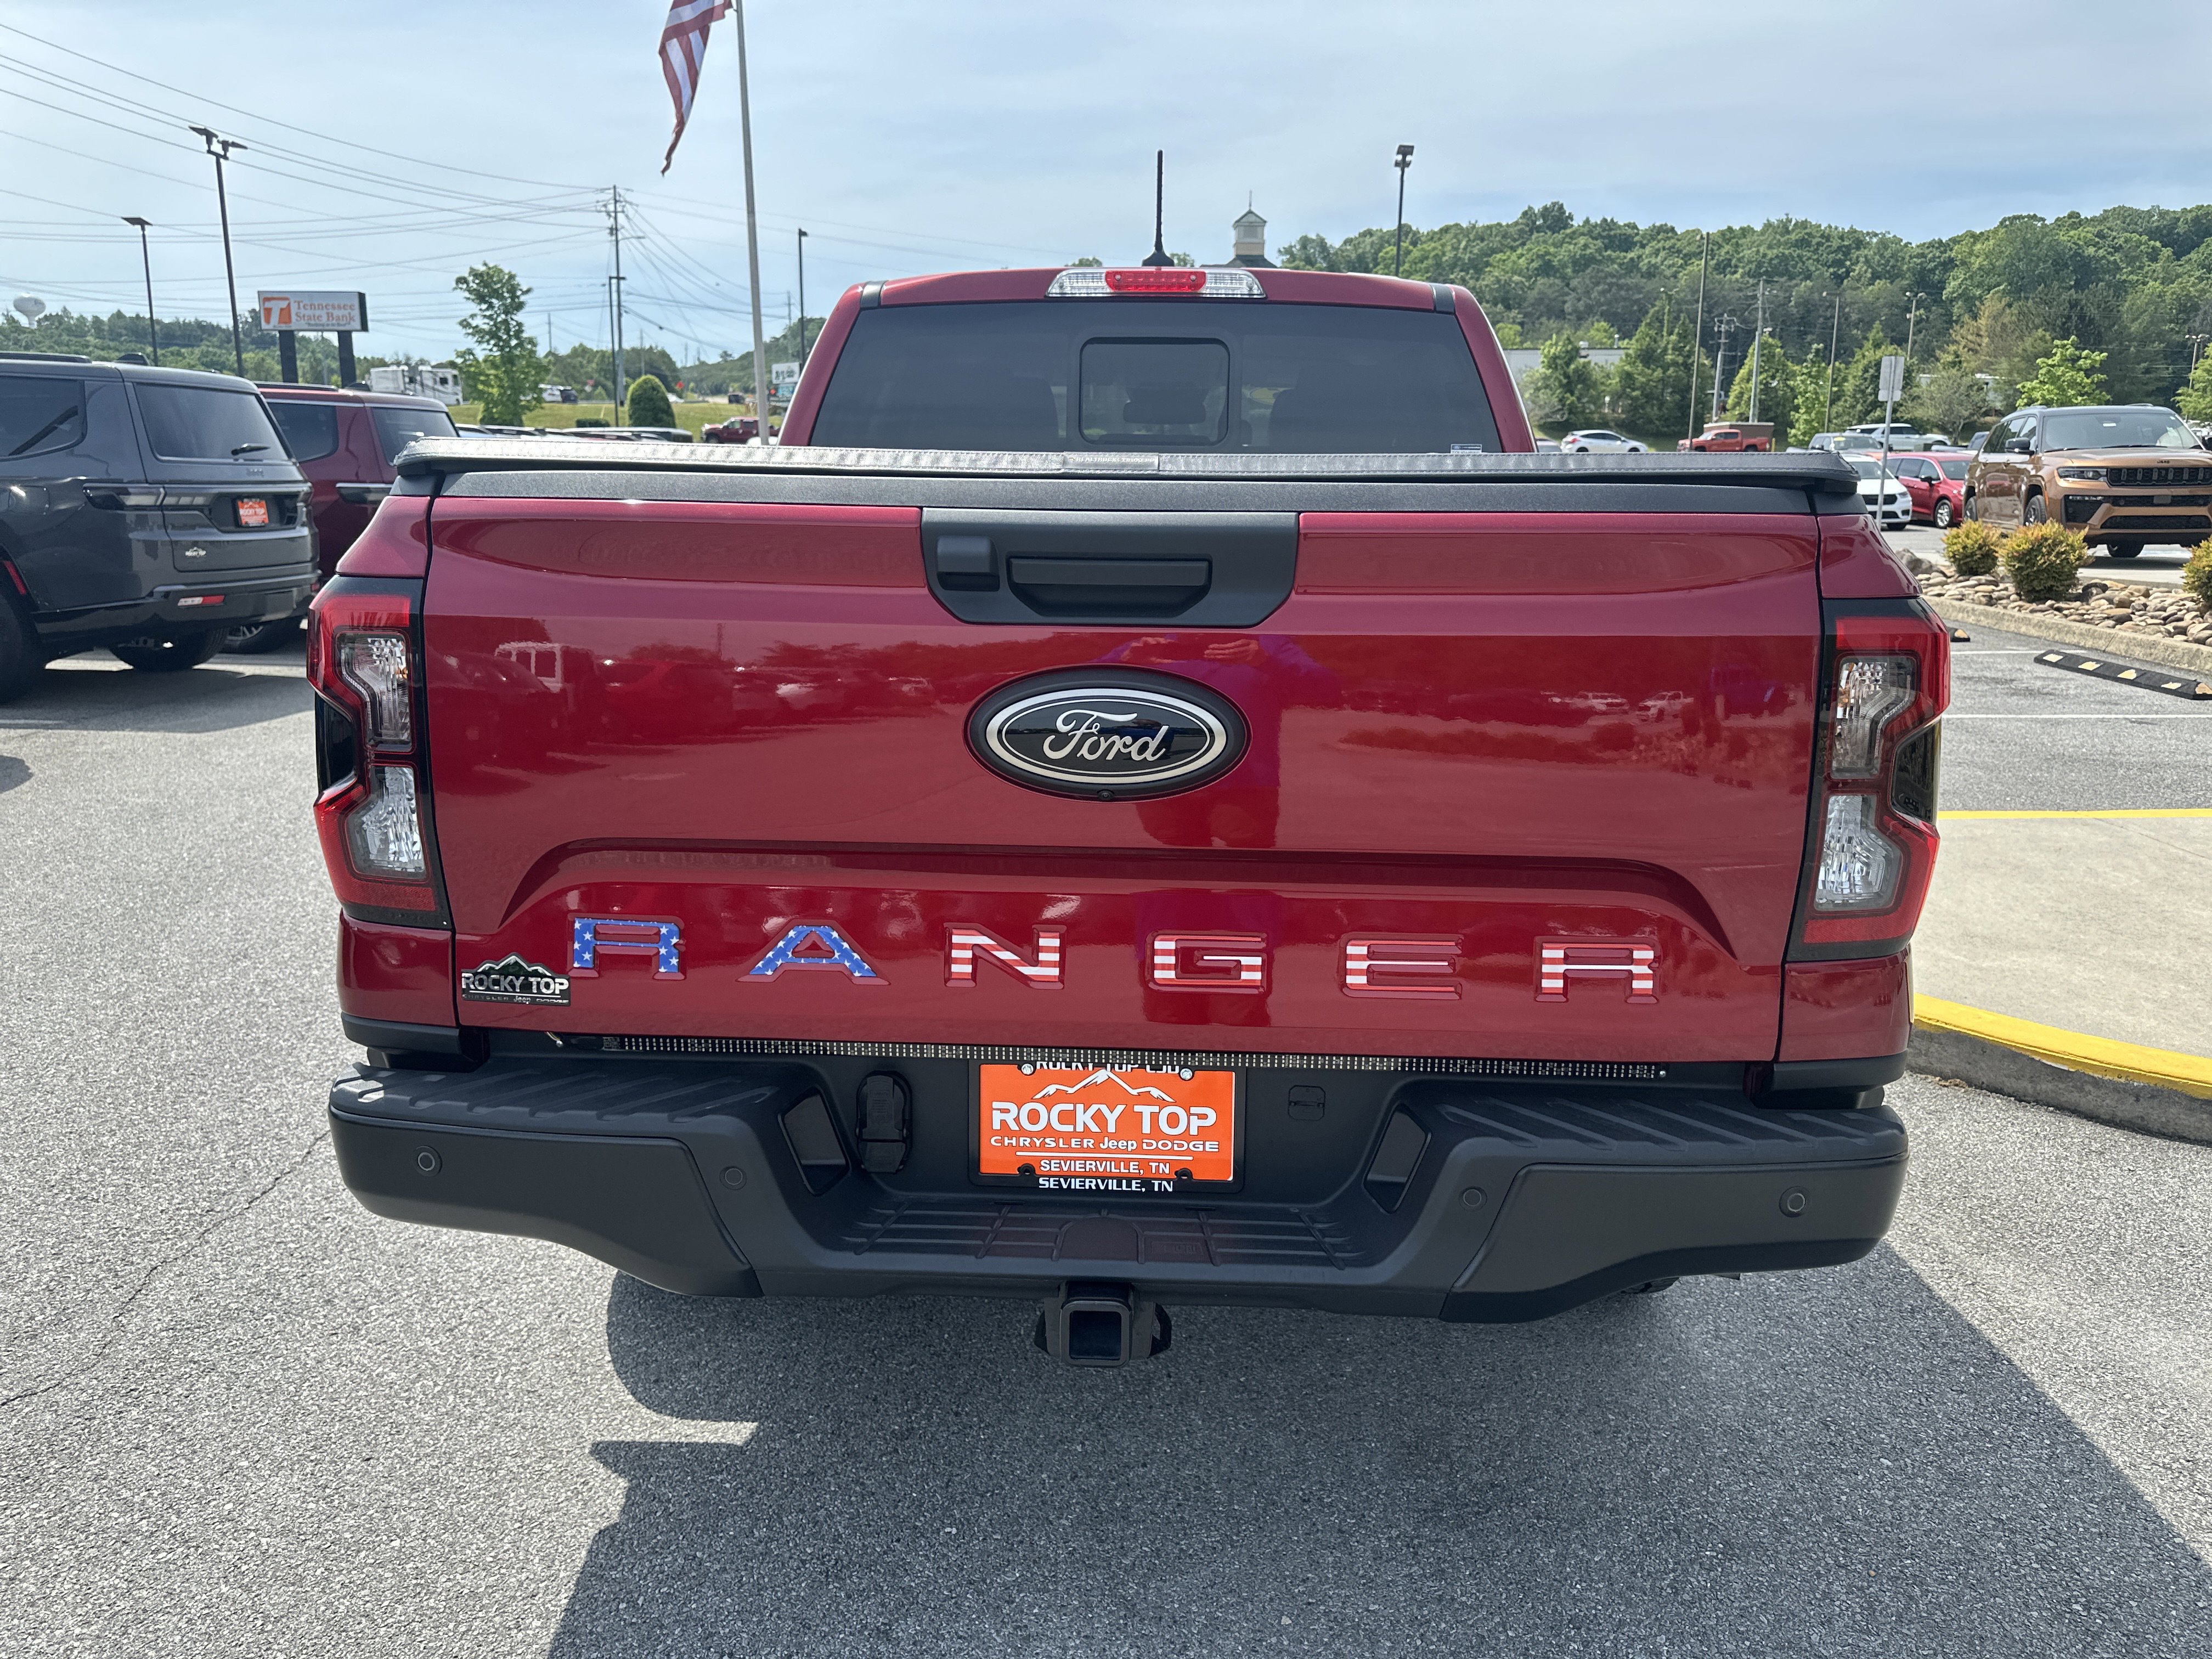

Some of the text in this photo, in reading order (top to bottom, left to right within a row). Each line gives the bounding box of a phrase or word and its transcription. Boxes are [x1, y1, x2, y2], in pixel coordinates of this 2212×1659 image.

[294, 300, 355, 311] Tennessee
[295, 312, 355, 323] State Bank
[1043, 709, 1169, 761] Ford
[572, 915, 1656, 1000] RANGER
[461, 973, 569, 995] ROCKY TOP
[513, 995, 531, 1003] Jeep
[991, 1101, 1217, 1136] ROCKY TOP
[990, 1135, 1220, 1153] CHRYSLER Jeep DODGE
[1040, 1159, 1171, 1176] SEVIERVILLE, TN
[1039, 1177, 1173, 1193] SEVIERVILLE, TN
